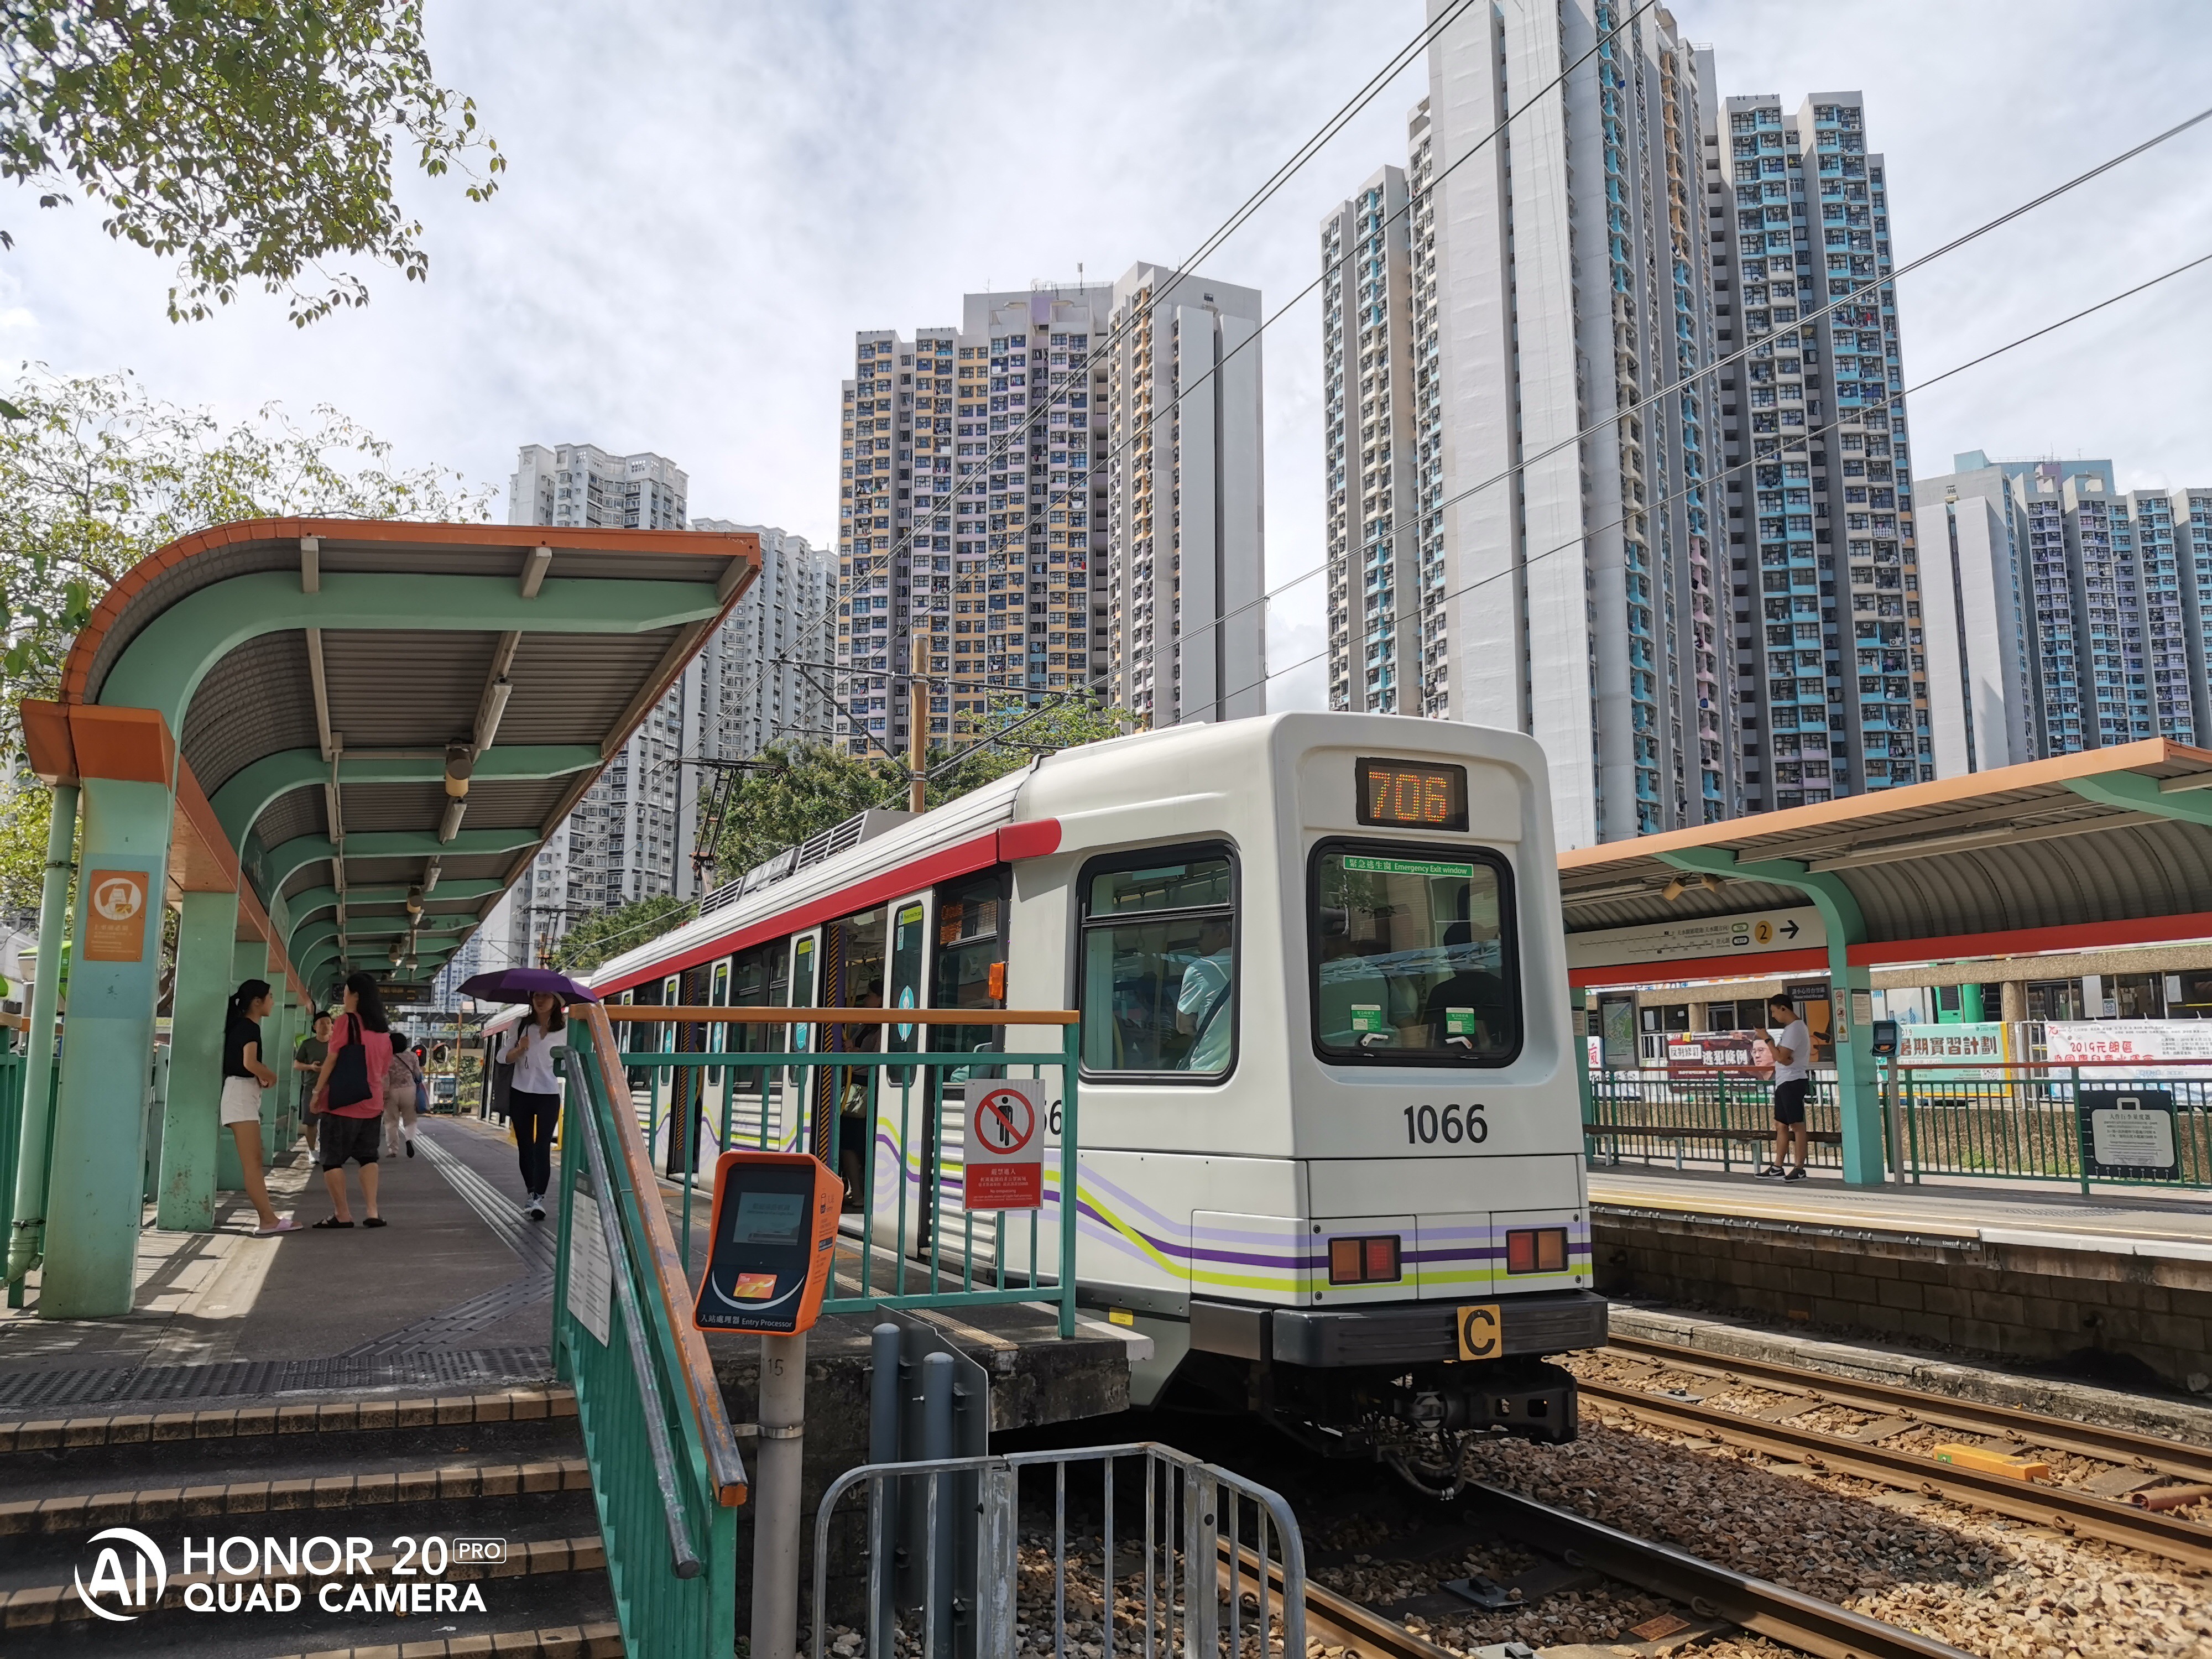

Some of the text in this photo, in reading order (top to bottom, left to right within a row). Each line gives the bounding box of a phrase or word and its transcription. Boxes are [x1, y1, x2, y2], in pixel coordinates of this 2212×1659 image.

[1368, 771, 1448, 822] 706
[1394, 863, 1430, 873] Emergency
[1442, 866, 1467, 874] window
[1760, 925, 1768, 940] 2
[1702, 1049, 1749, 1066] 逃犯條例
[1404, 1104, 1488, 1144] 1066
[700, 1314, 792, 1328] 入站處理器 Entry Processor
[1464, 1309, 1496, 1356] C
